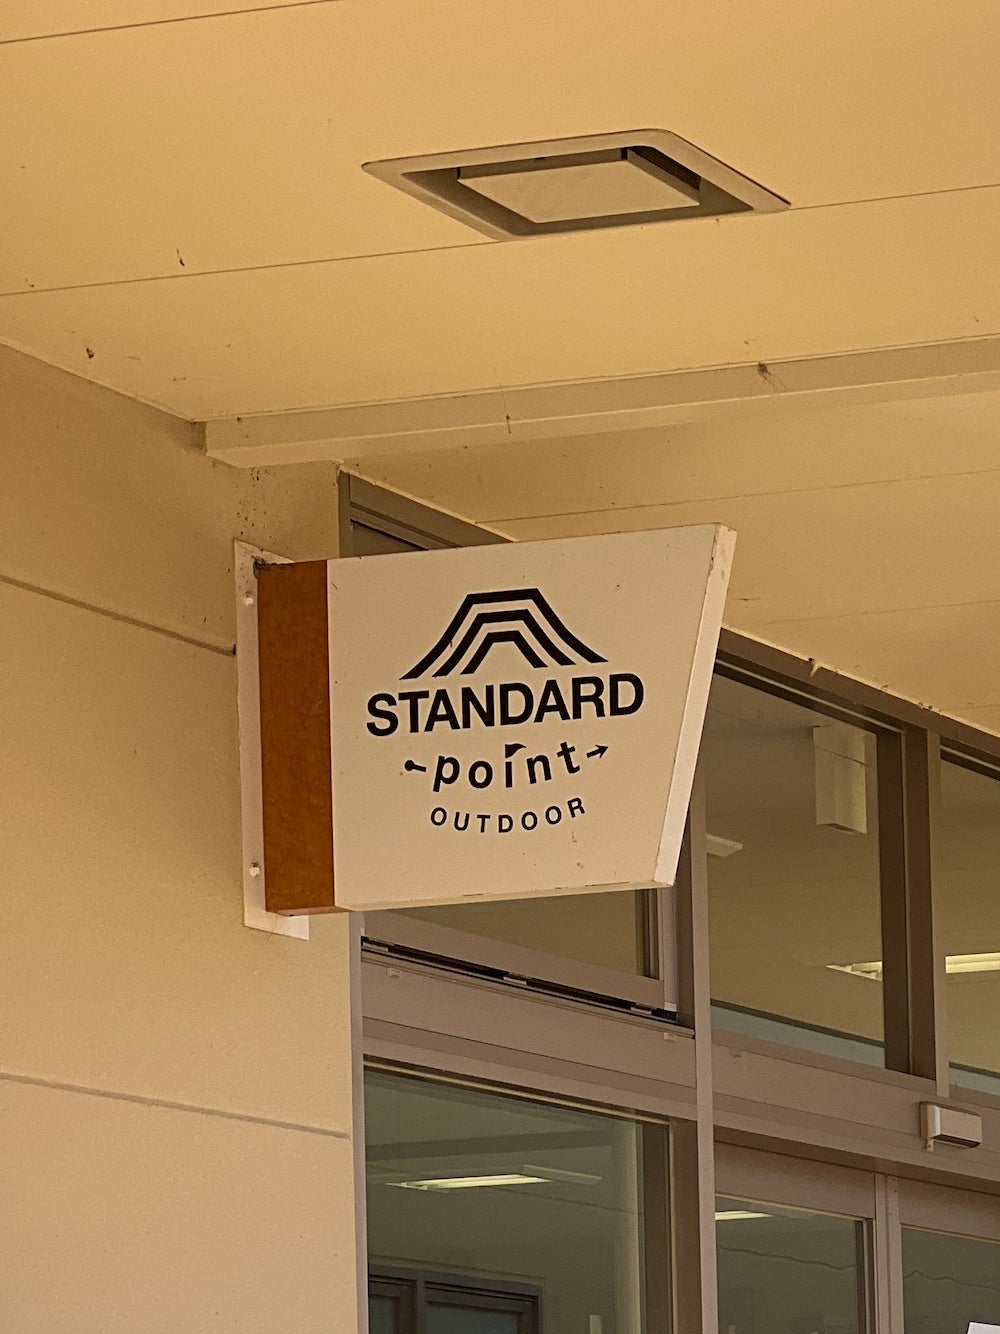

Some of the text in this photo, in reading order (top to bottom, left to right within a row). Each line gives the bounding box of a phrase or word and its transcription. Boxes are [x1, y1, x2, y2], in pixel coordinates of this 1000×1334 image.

[366, 672, 644, 737] STANDARD
[432, 741, 581, 793] point
[430, 797, 586, 833] OUTDOOR
